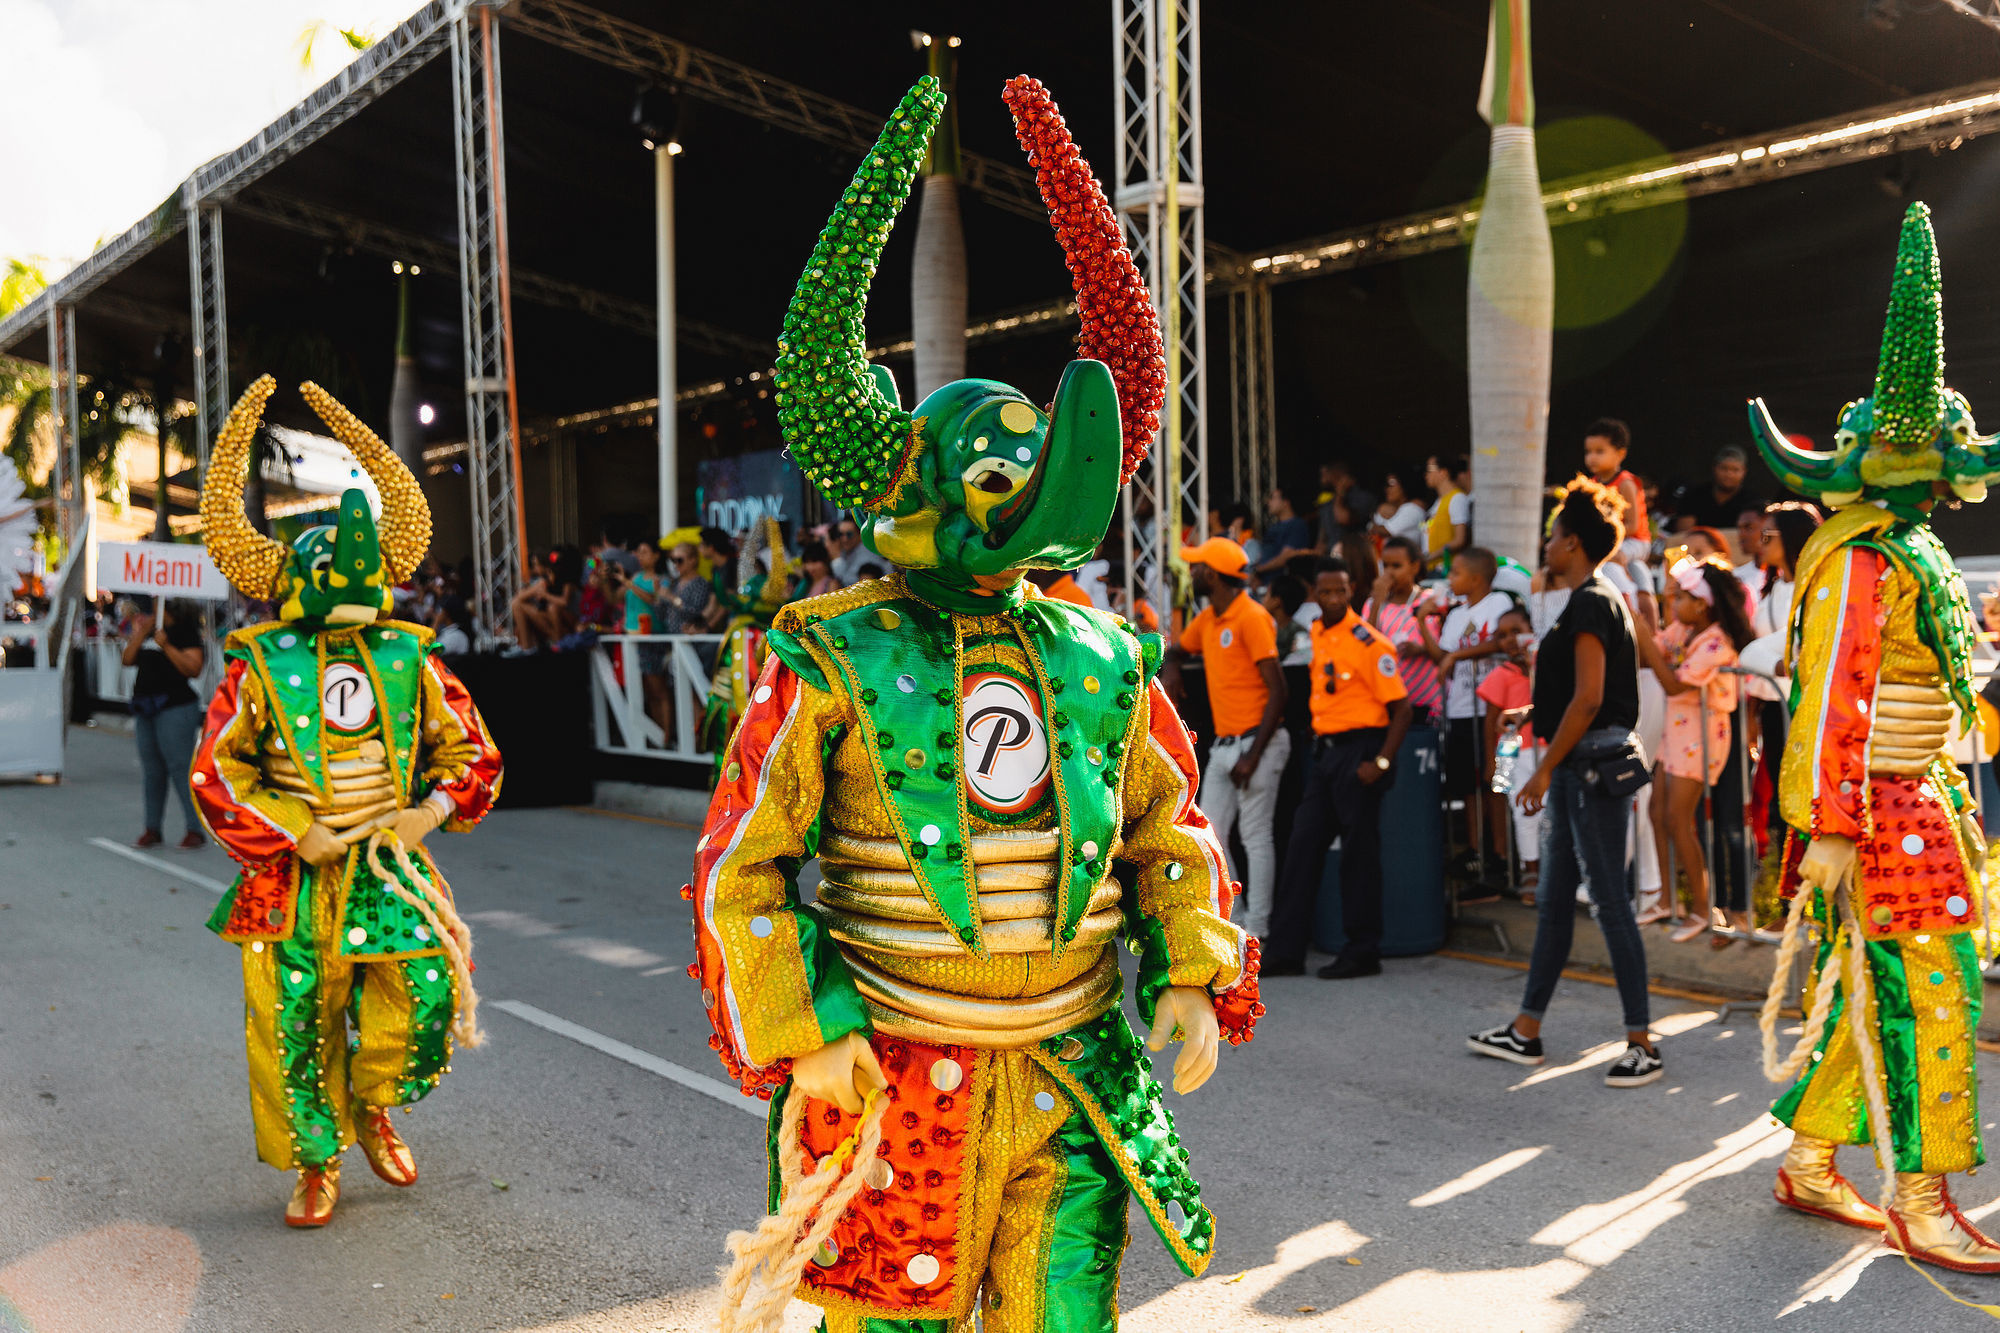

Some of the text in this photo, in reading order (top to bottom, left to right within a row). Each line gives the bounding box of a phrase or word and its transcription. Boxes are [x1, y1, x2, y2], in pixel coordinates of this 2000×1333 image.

[124, 550, 203, 588] Miami
[325, 677, 360, 717] P
[965, 706, 1033, 778] P
